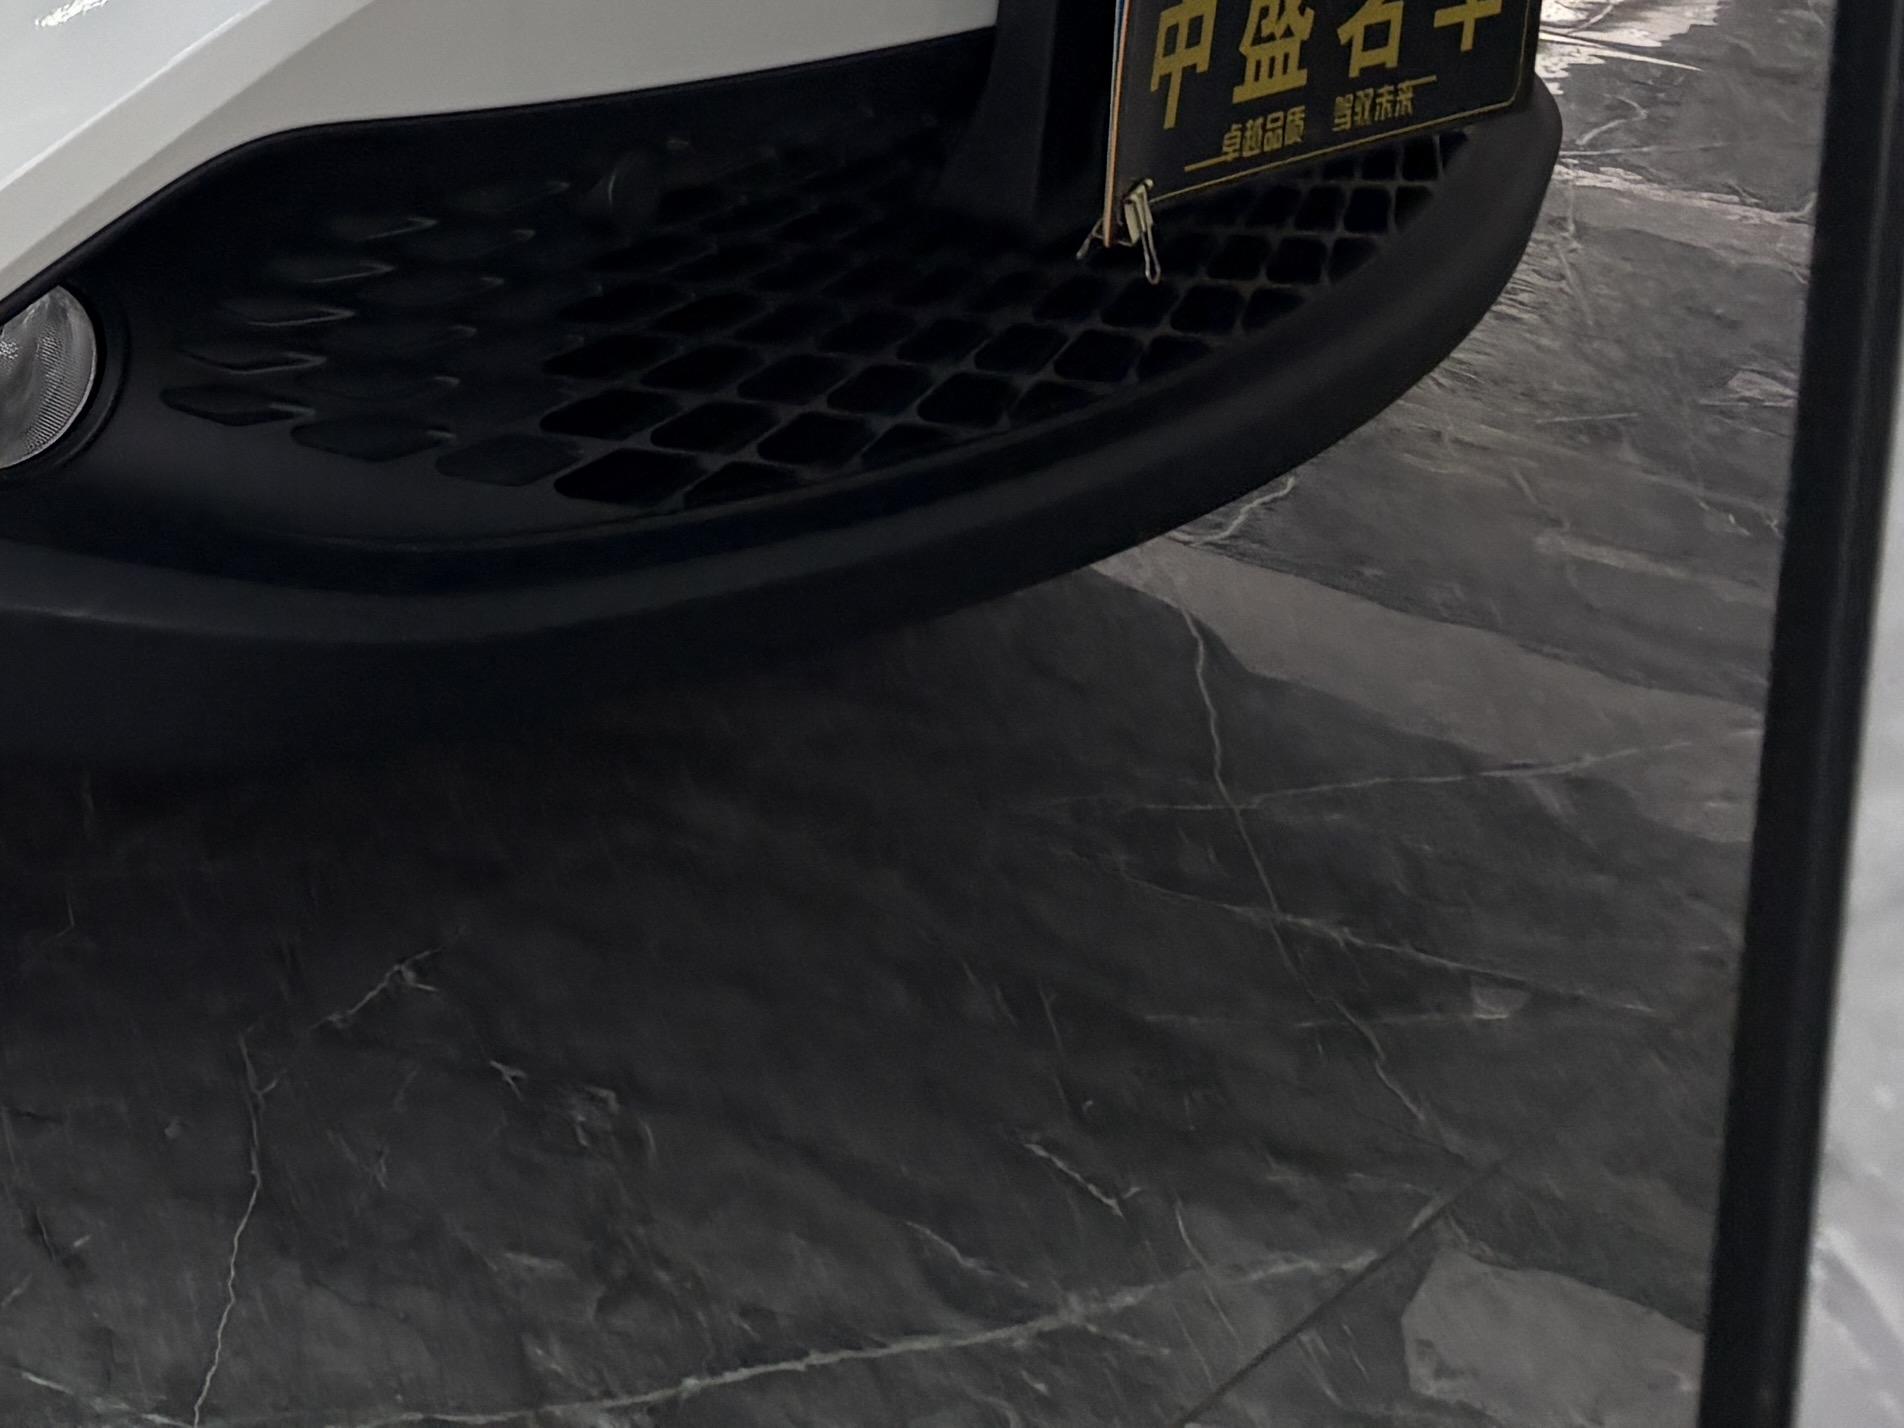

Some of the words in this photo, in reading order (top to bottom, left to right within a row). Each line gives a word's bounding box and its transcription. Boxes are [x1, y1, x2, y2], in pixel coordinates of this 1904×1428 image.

[1219, 104, 1306, 163] 卓越品质
[1332, 80, 1416, 132] 驾驭未来
